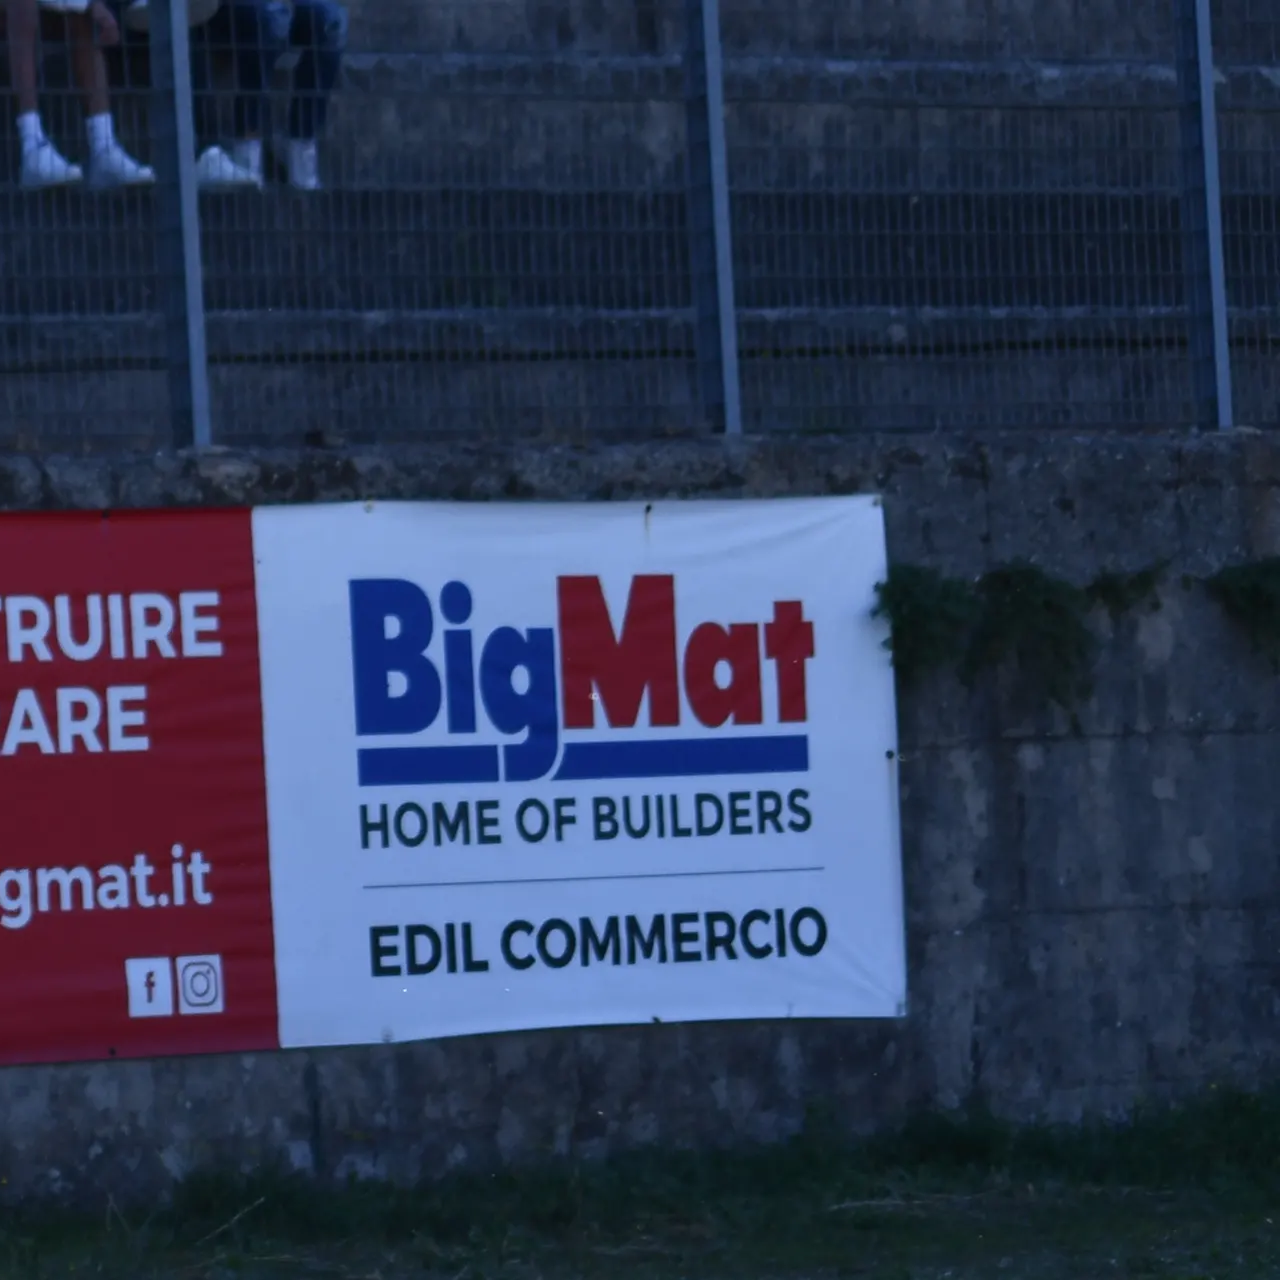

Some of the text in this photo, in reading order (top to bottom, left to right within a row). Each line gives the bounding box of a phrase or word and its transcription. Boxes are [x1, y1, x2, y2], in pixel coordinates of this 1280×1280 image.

[348, 574, 815, 783] BigMat
[359, 788, 813, 849] HOME OF BUILDERS
[370, 907, 828, 977] EDIL COMMERCIO
